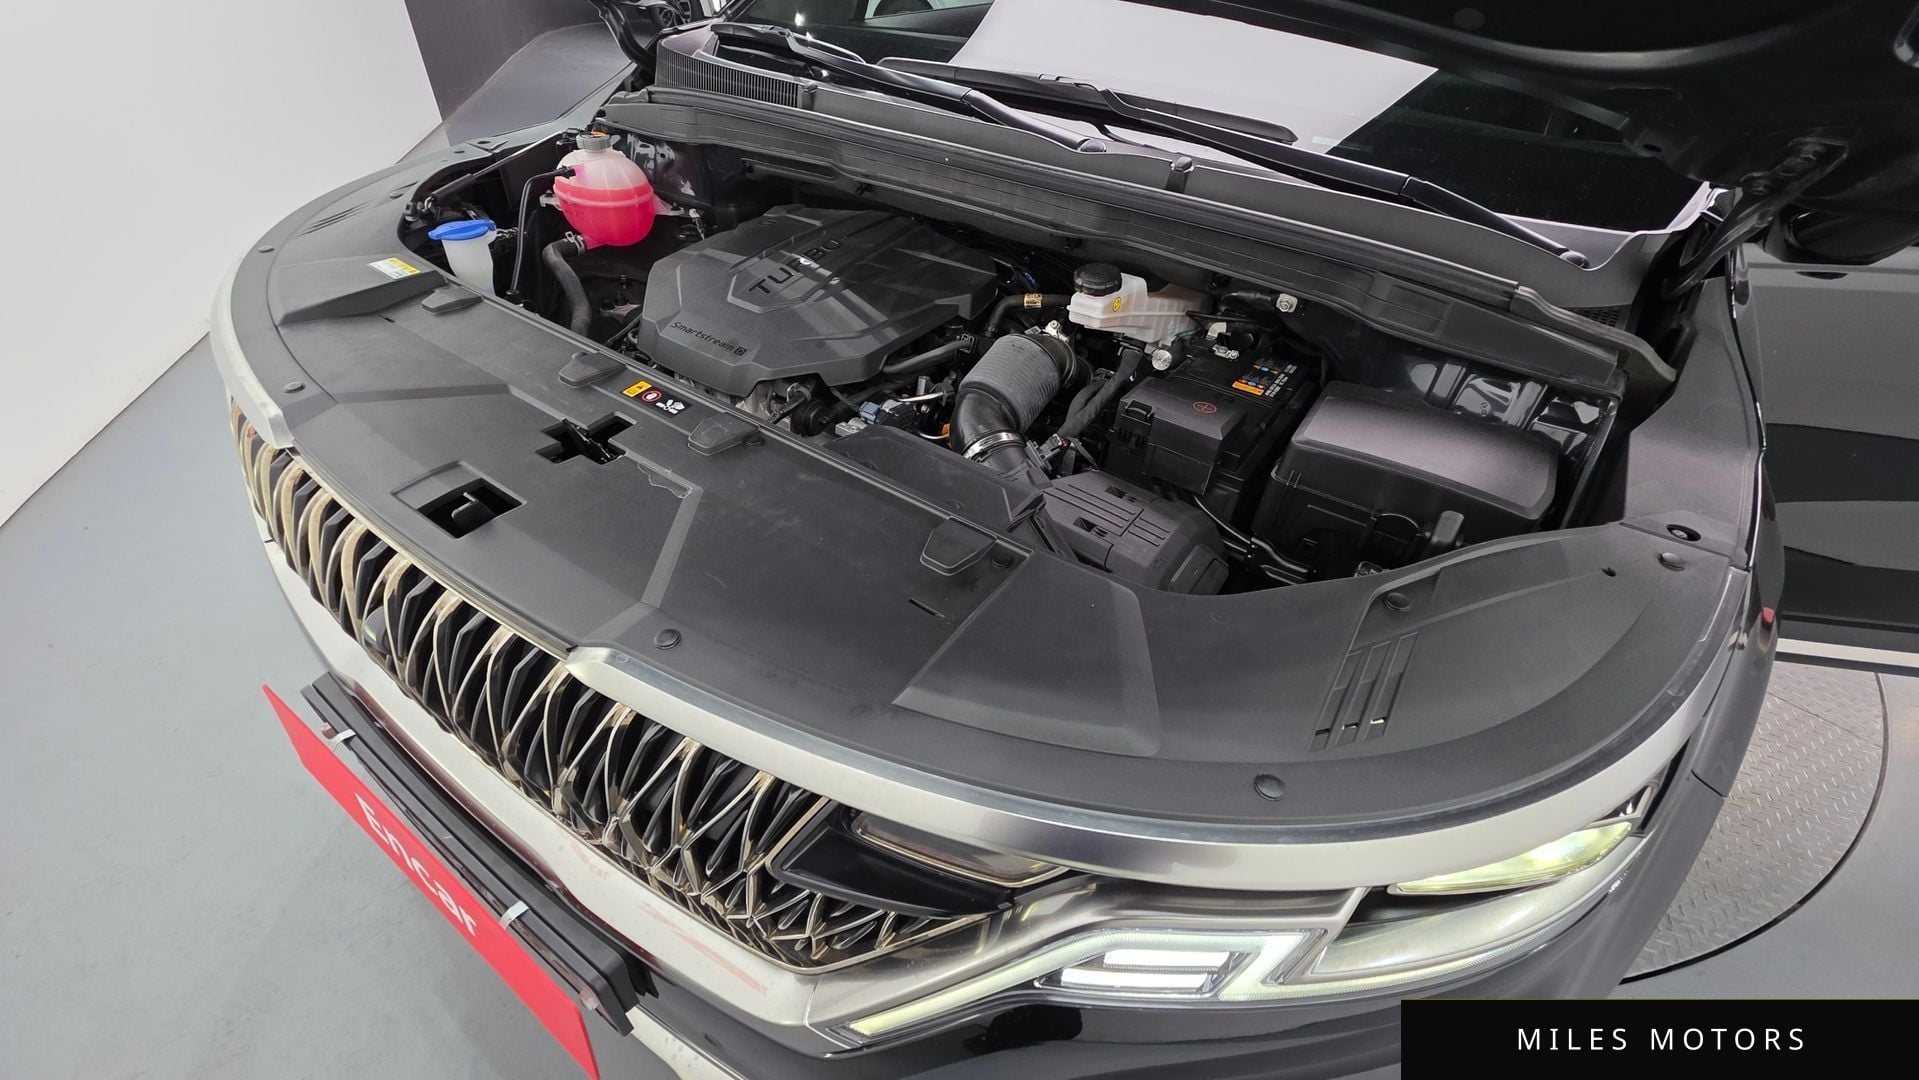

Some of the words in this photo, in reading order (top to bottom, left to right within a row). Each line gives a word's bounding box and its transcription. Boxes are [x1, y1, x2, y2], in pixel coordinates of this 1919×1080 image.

[748, 239, 841, 295] TURBO
[670, 321, 735, 352] Smartstream
[354, 792, 477, 938] Encar
